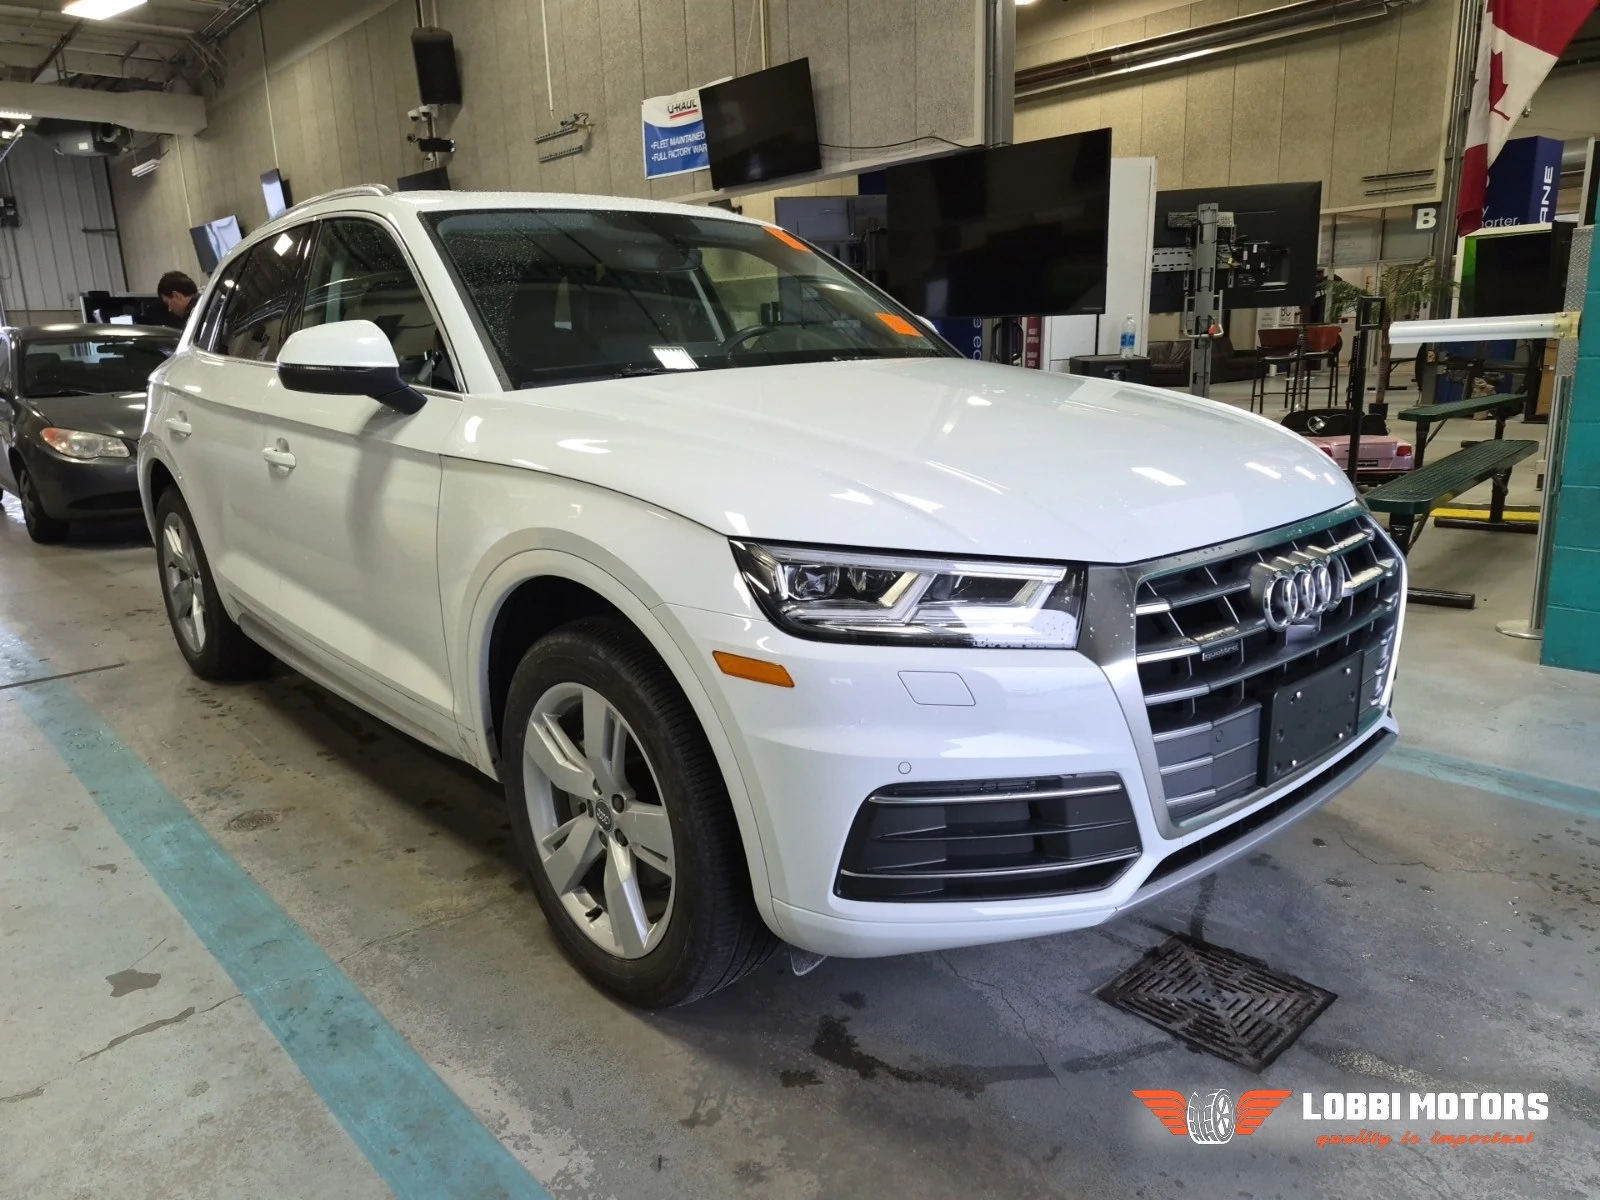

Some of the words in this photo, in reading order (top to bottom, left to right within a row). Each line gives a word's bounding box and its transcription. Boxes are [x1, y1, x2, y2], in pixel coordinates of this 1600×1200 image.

[670, 131, 706, 146] MAINTAINED
[668, 147, 691, 159] FACTORY
[1416, 208, 1437, 229] B
